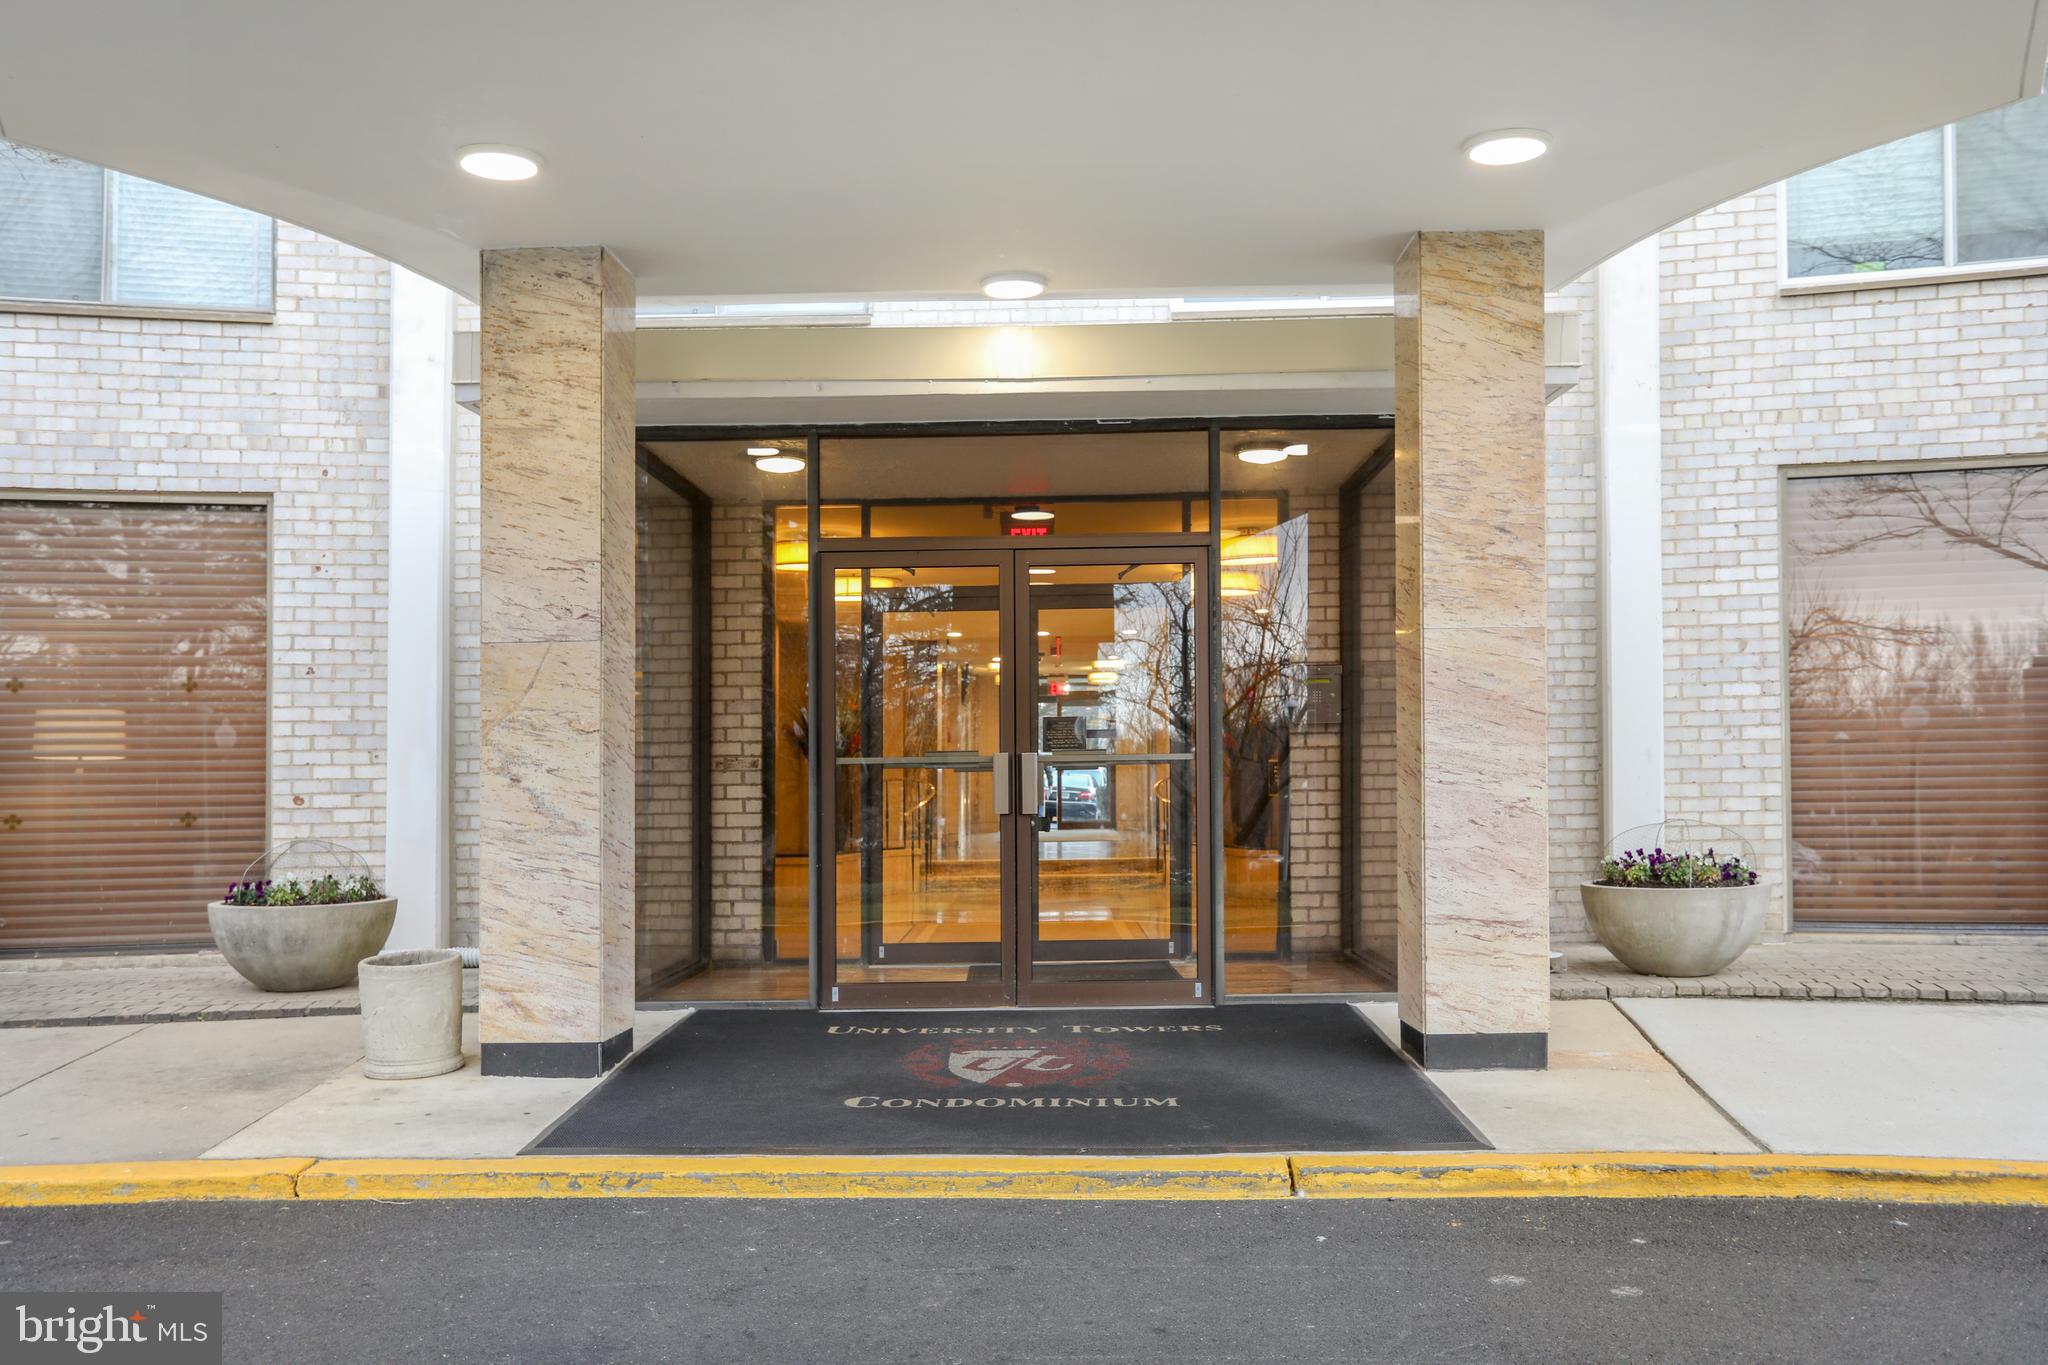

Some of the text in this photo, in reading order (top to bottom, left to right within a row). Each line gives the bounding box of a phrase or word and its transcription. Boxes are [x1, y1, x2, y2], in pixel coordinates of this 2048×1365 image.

[827, 1024, 1224, 1035] UNIVERSITY TOWERS
[843, 1095, 1181, 1108] CONDOMINIUM
